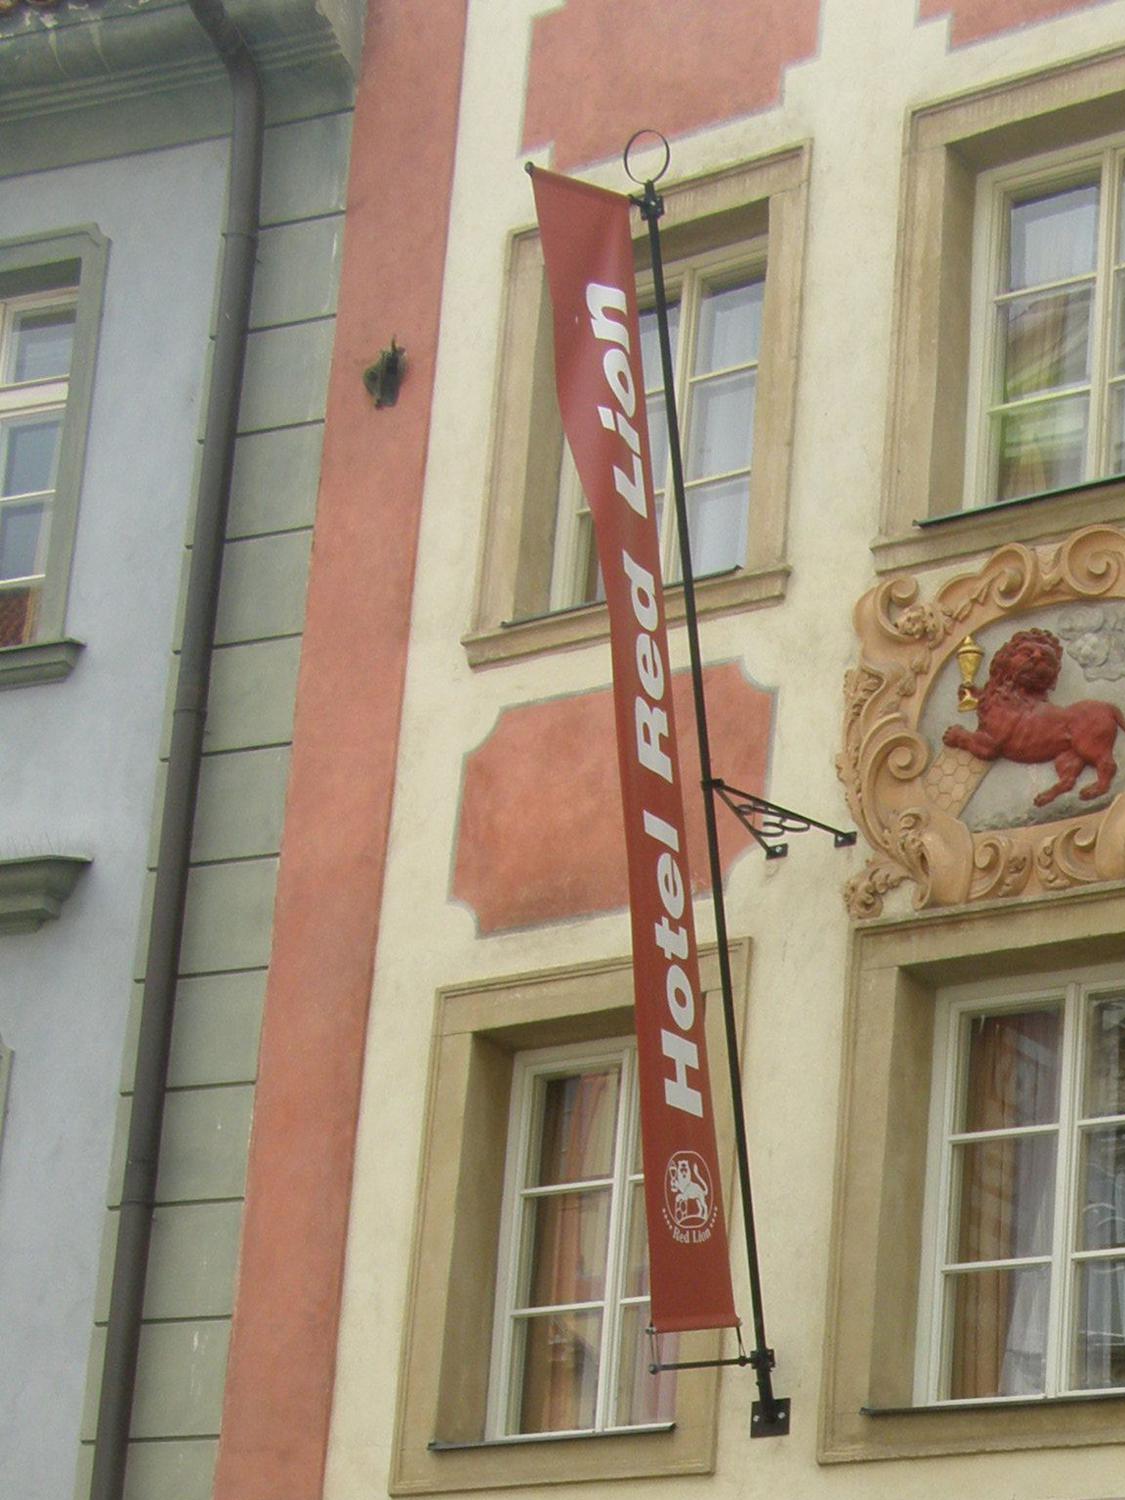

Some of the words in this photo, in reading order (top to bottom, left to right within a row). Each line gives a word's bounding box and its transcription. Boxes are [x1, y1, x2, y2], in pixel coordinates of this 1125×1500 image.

[586, 283, 648, 519] Lion
[622, 550, 674, 785] Red
[643, 809, 703, 1118] Hotel
[672, 1227, 690, 1244] Red
[693, 1229, 711, 1244] Lion
